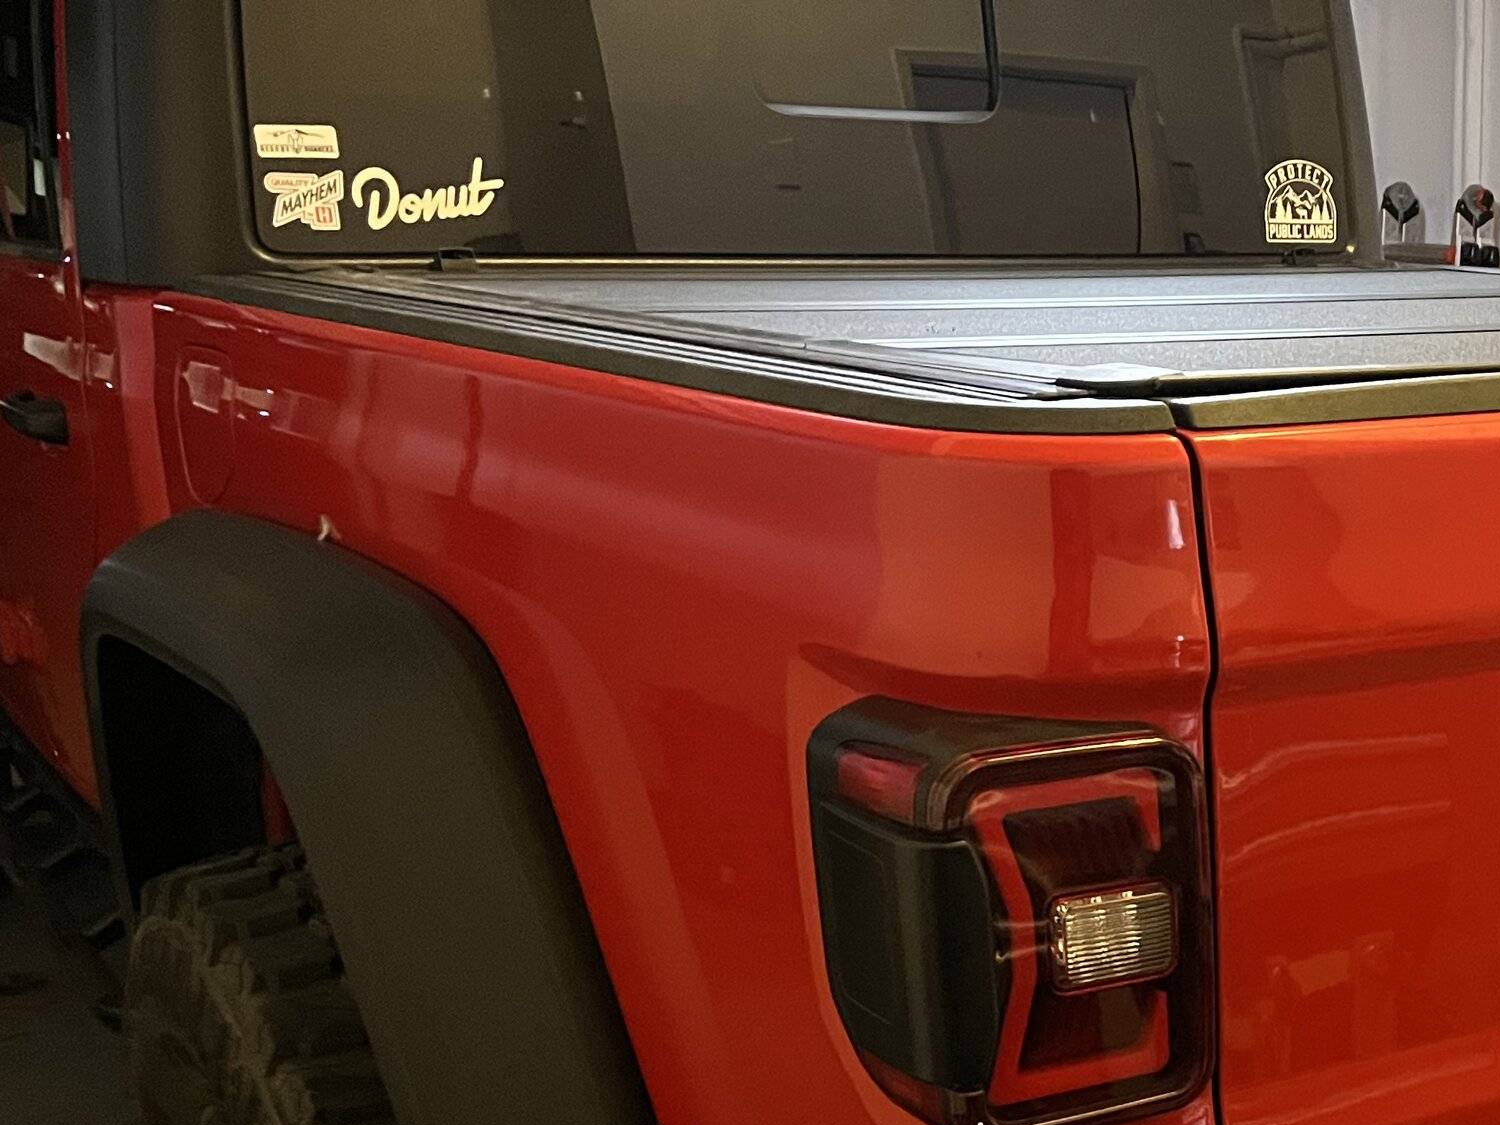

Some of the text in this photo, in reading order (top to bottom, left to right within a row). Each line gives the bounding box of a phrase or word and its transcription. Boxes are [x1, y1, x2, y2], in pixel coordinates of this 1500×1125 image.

[1269, 163, 1330, 189] PROTECT
[281, 179, 338, 217] MAYHEM
[351, 156, 504, 230] Donut
[1269, 223, 1334, 239] PUBLIC LANDS
